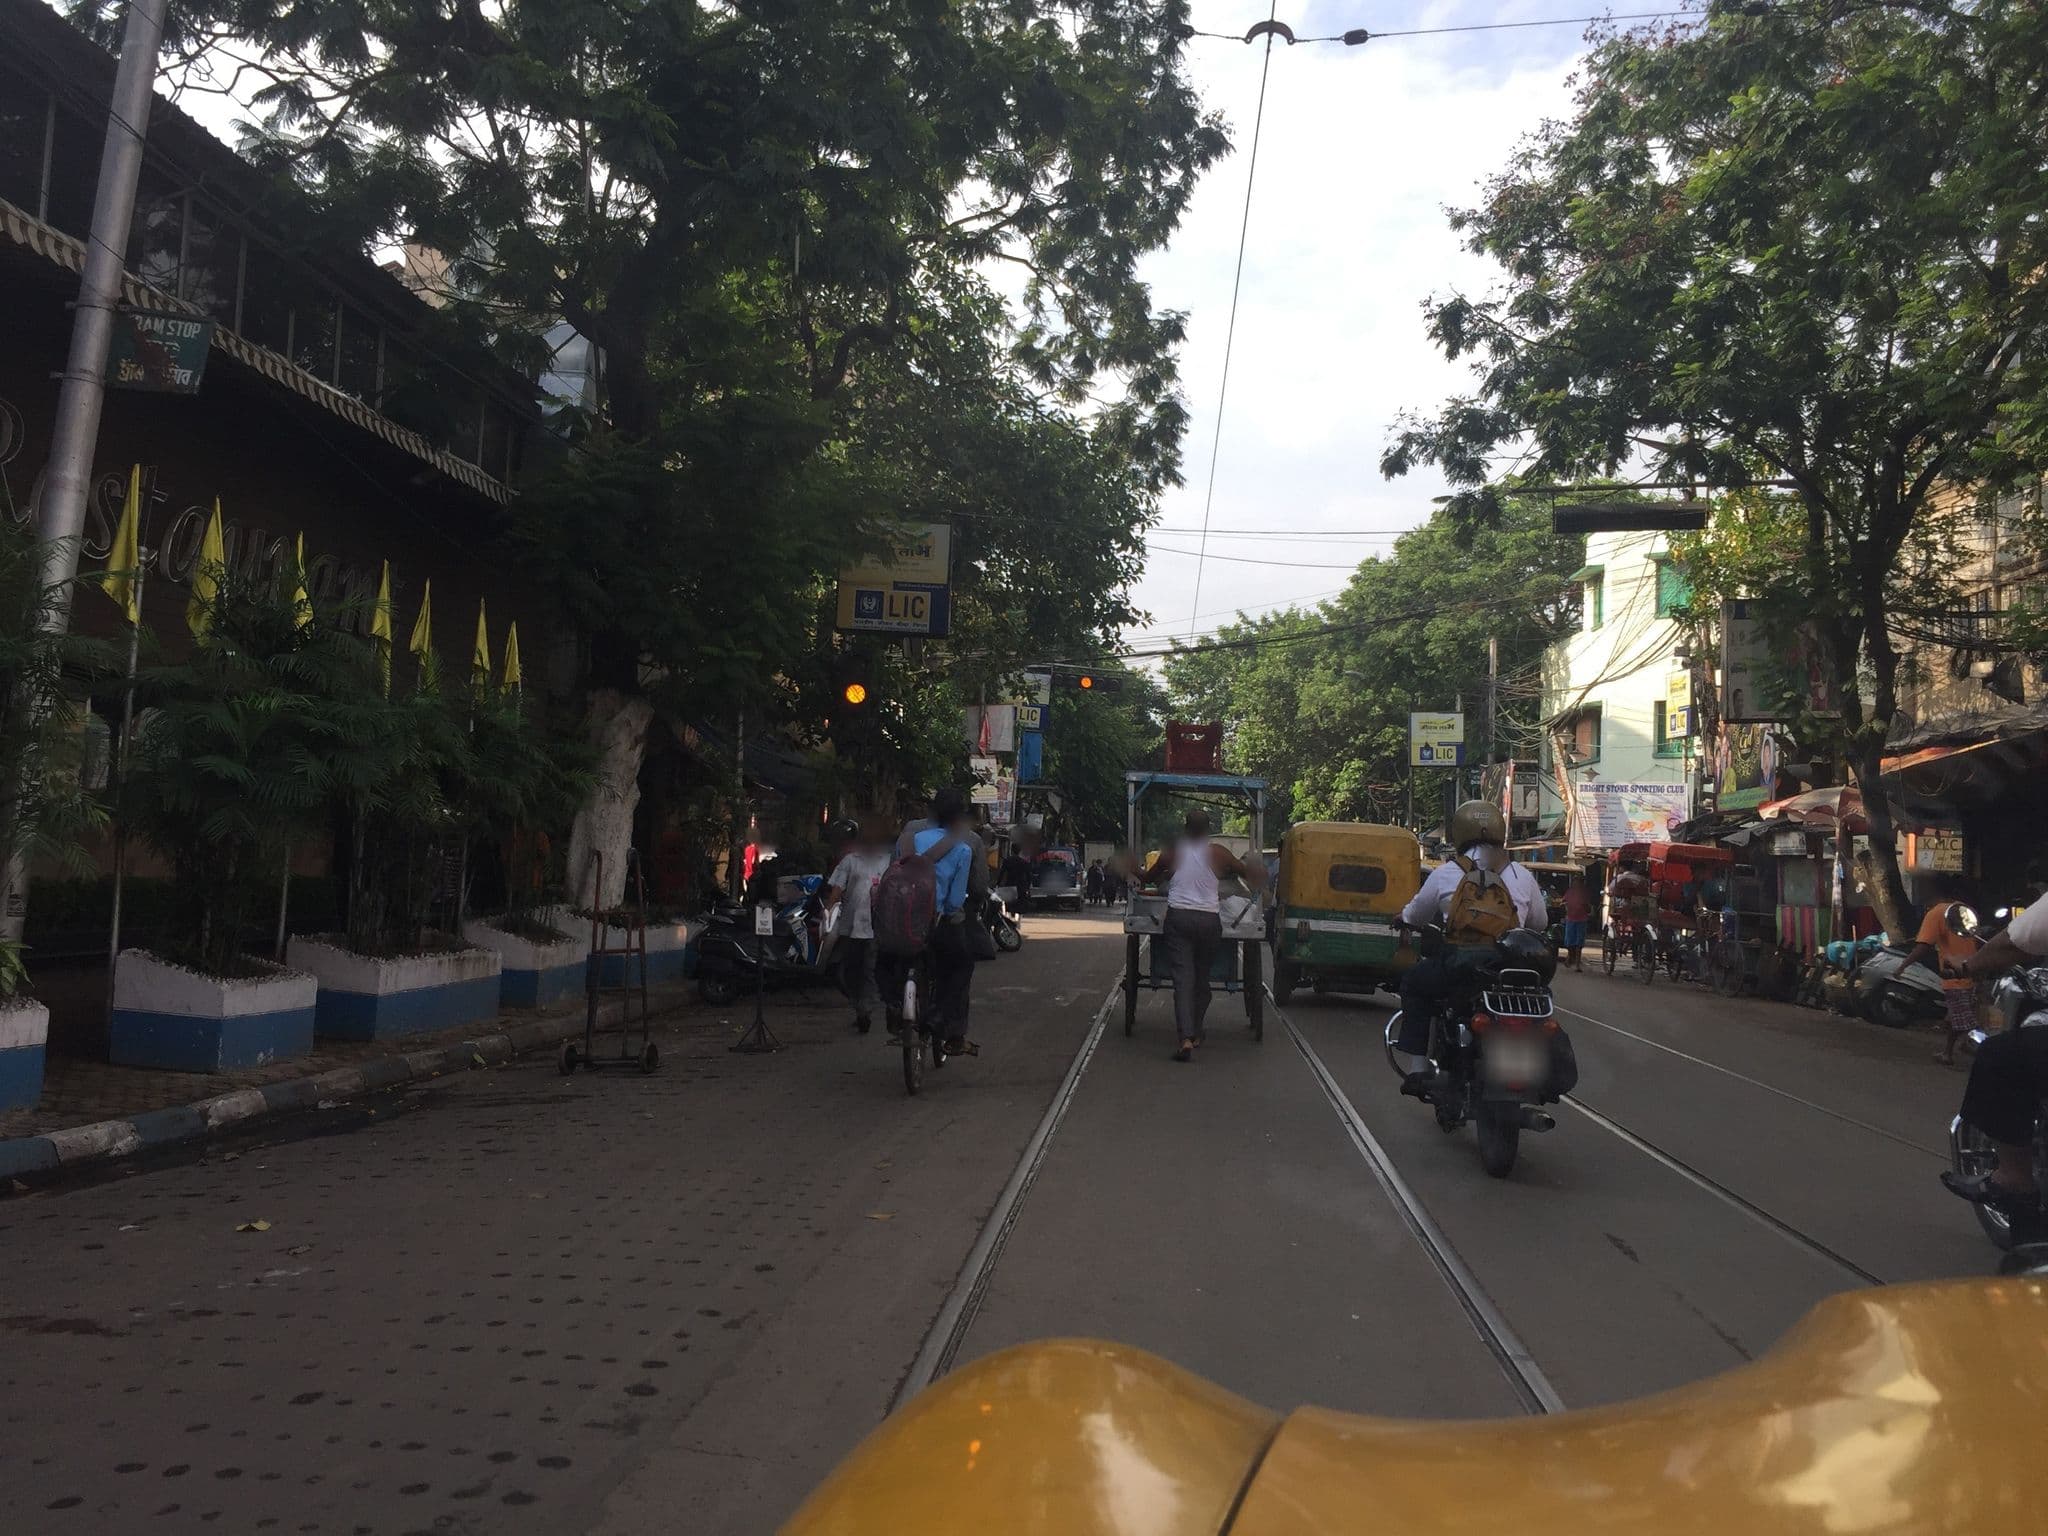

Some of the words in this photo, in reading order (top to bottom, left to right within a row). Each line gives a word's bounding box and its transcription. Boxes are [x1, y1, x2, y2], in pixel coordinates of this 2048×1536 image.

[166, 319, 202, 339] STOP
[888, 594, 924, 618] LIC
[1019, 708, 1037, 721] LIC
[1435, 748, 1453, 760] LIC
[1579, 784, 1605, 793] BRIGHT
[1630, 784, 1665, 794] SPORTING
[1666, 785, 1685, 794] CLUB
